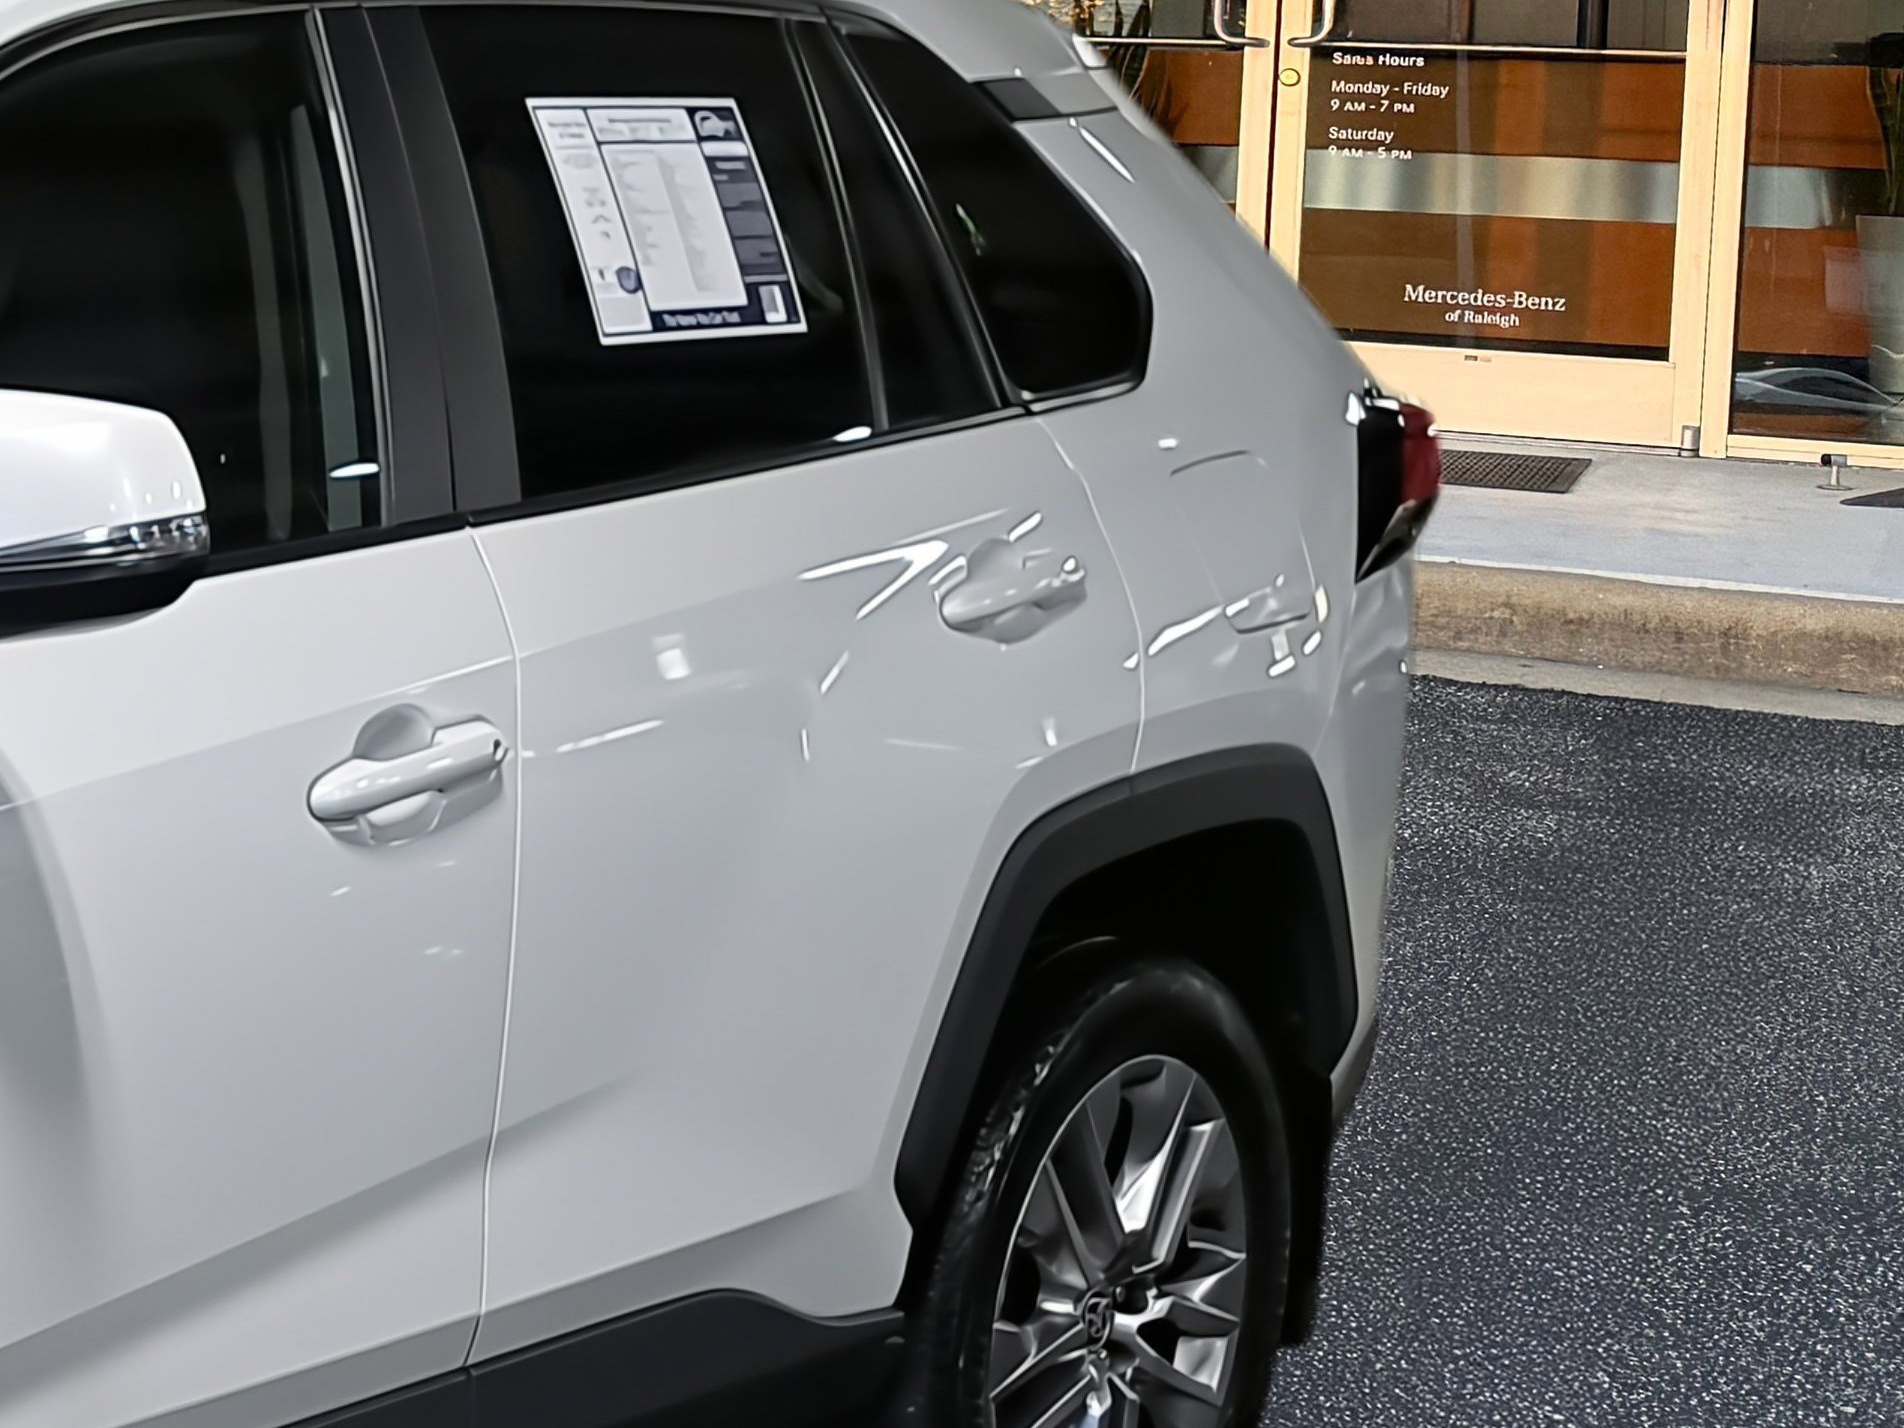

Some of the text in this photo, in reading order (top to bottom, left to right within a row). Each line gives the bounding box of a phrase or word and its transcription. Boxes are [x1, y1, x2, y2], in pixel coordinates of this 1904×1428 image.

[1378, 53, 1425, 67] Hours
[1331, 79, 1390, 97] Monday
[1403, 81, 1449, 98] Friday
[1330, 98, 1340, 111] 9
[1343, 101, 1366, 112] AM
[1380, 100, 1390, 112] 7
[1393, 102, 1415, 113] PM
[1328, 126, 1394, 144] Saturday
[1328, 145, 1338, 157] 9
[1342, 148, 1364, 158] AM
[1377, 146, 1387, 159] 5
[1391, 149, 1412, 160] PM
[1404, 284, 1566, 311] Mercedes-Benz
[1445, 309, 1521, 329] of Raleigh
